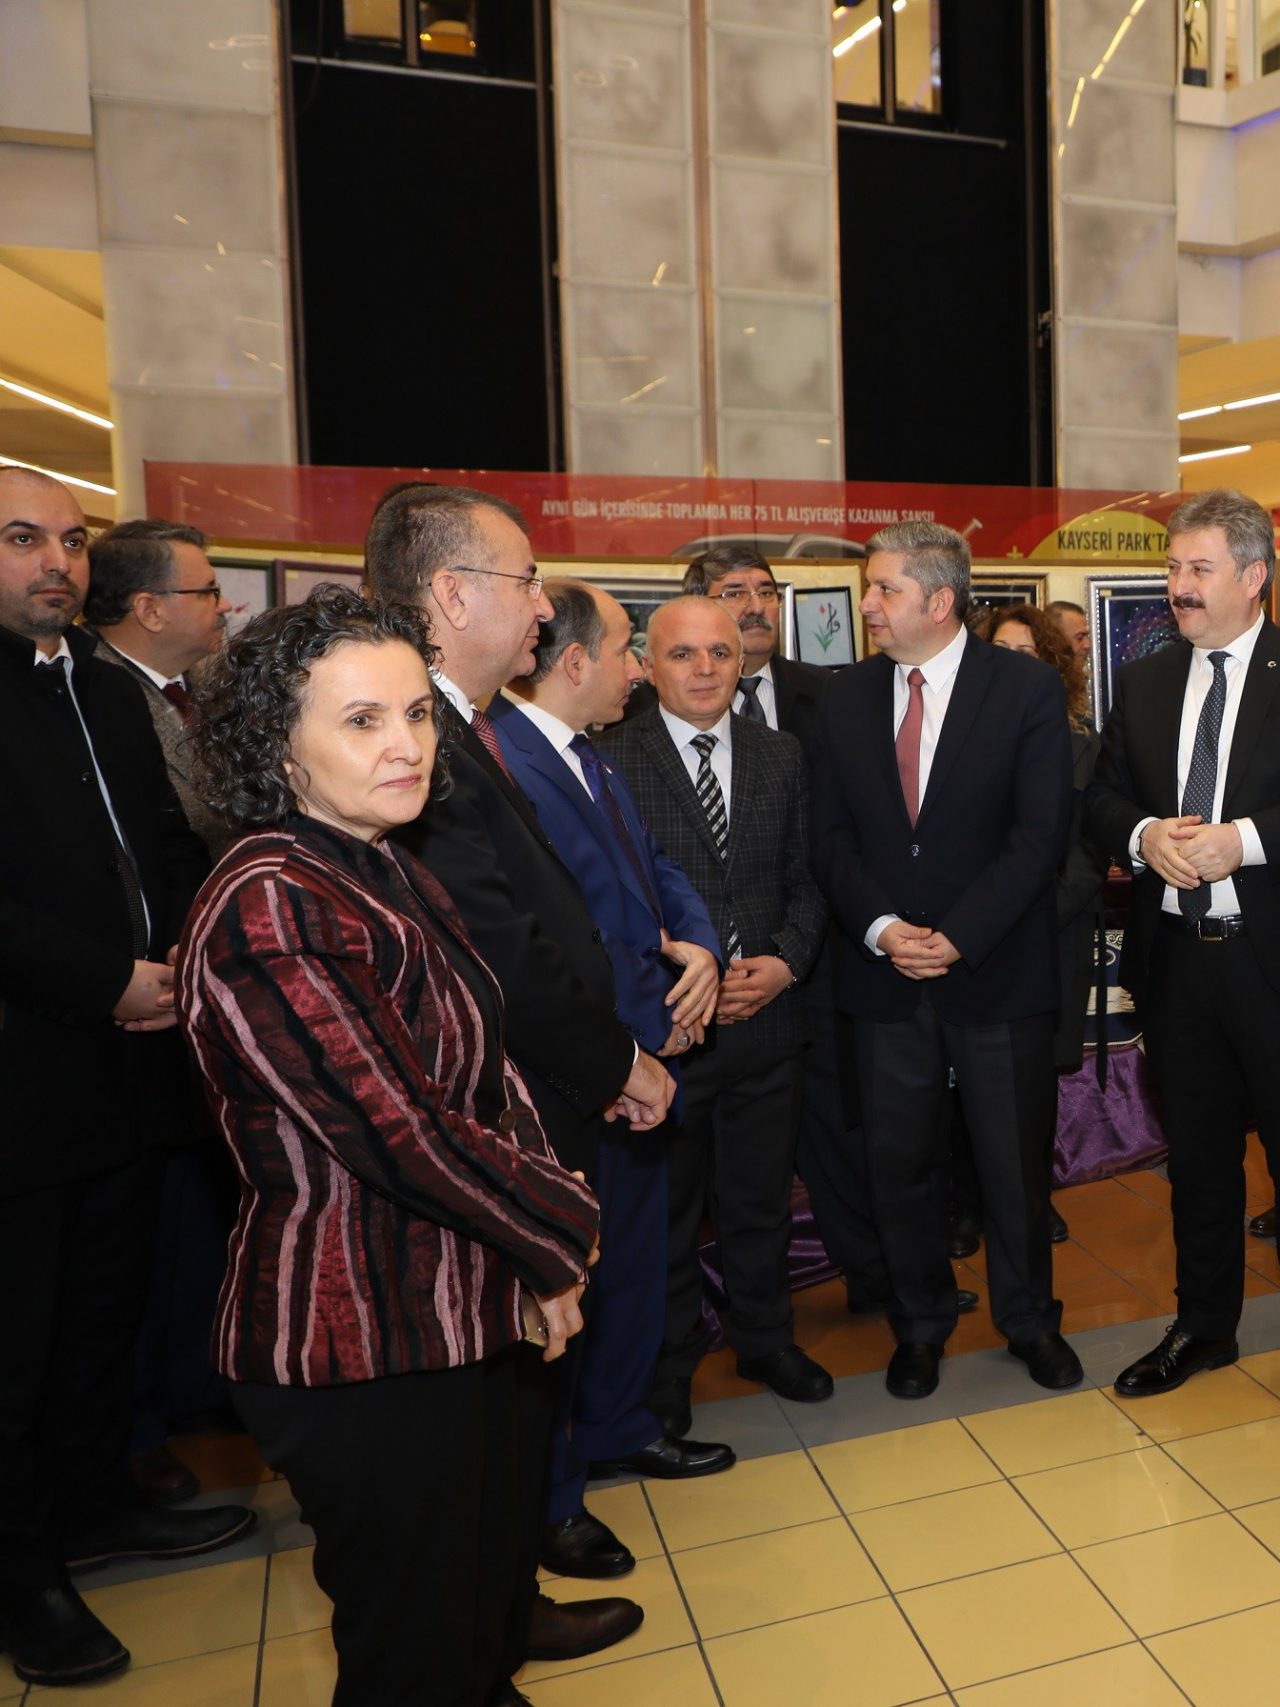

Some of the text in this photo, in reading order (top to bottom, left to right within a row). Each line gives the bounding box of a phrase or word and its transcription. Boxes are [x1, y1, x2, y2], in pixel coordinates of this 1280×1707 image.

[542, 499, 570, 516] AYNI
[573, 498, 597, 517] GÜN
[600, 498, 663, 521] İÇERİSİNDE
[667, 502, 727, 520] TOPLAMDA
[731, 505, 751, 520] HER
[755, 505, 767, 521] 75
[772, 505, 783, 521] TL
[787, 504, 846, 526] ALIŞVERİŞE
[848, 507, 898, 523] KAZANMA
[1057, 528, 1171, 552] KAYSERİ PARK'TA
